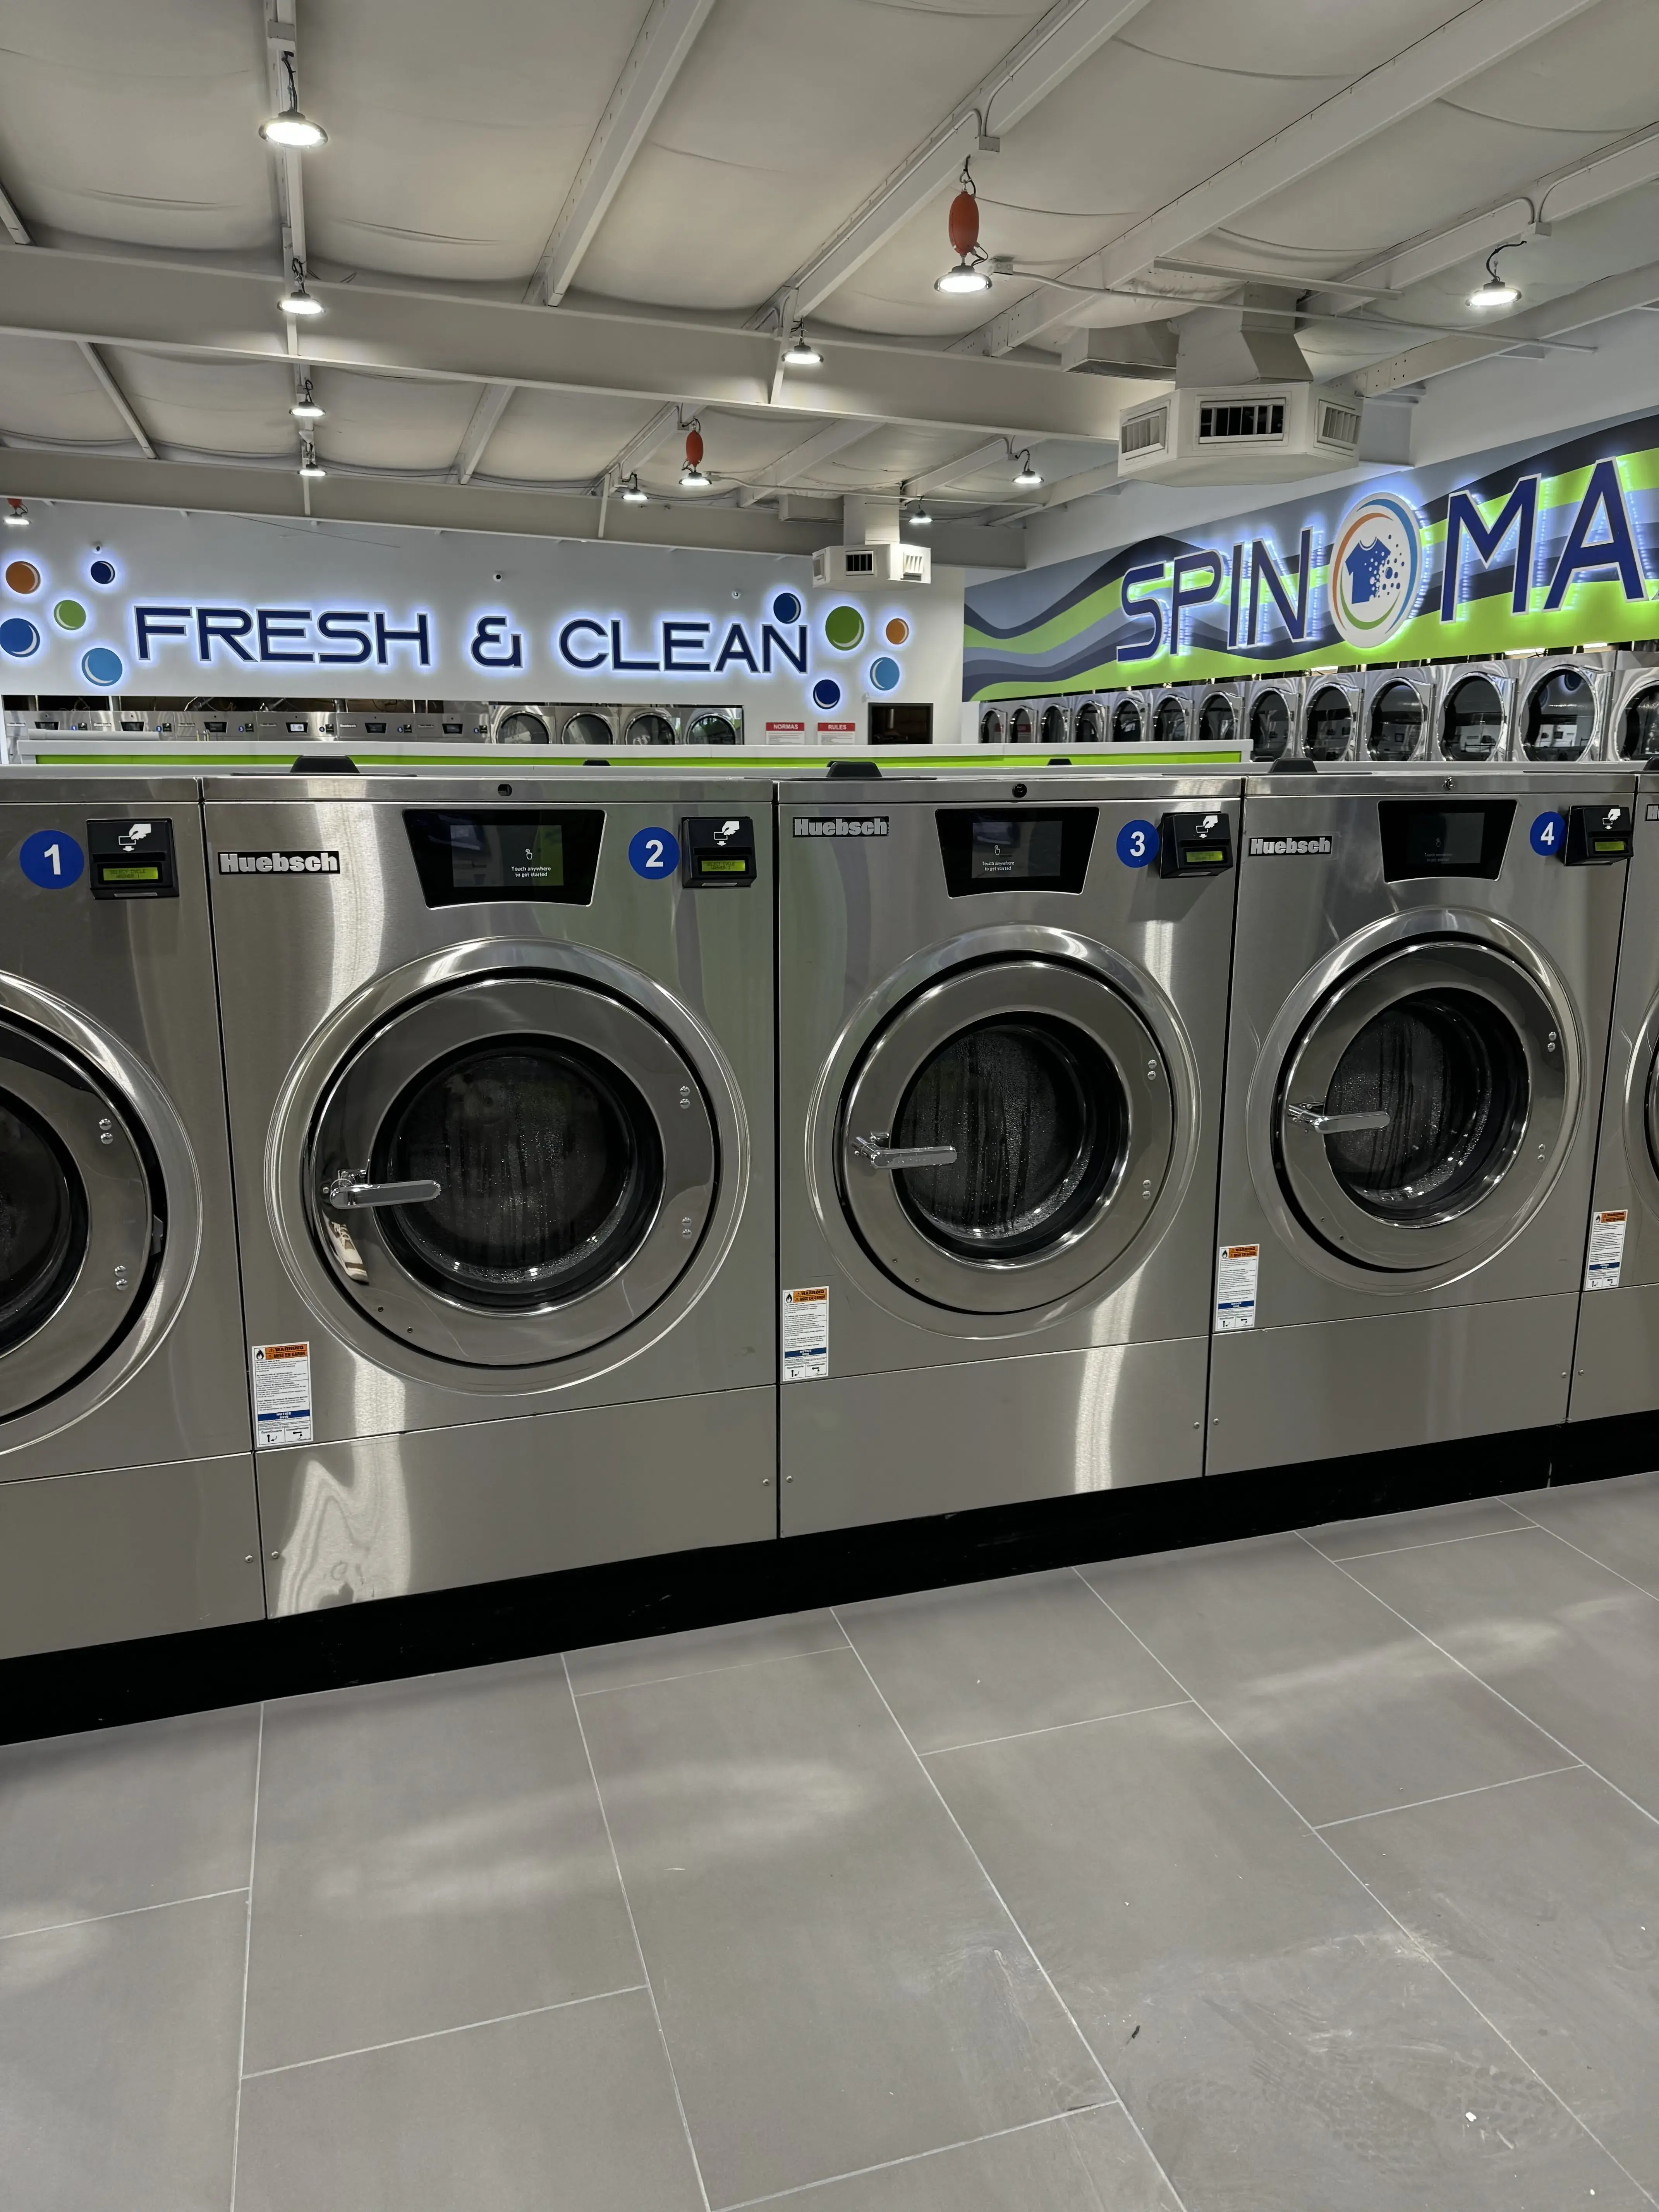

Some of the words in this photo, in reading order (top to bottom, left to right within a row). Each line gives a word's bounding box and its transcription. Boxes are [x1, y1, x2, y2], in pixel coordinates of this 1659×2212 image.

[1116, 527, 1313, 663] SPIN
[1439, 457, 1659, 623] MA
[134, 605, 431, 666] FRESH
[471, 616, 523, 668] &
[559, 618, 808, 674] CLEAN
[795, 818, 887, 835] Huebsch
[1540, 822, 1554, 845] 4
[646, 840, 663, 867] 2
[1130, 831, 1145, 857] 3
[1250, 837, 1331, 854] Huebsch
[44, 844, 61, 875] 1
[220, 853, 338, 872] Huebsch
